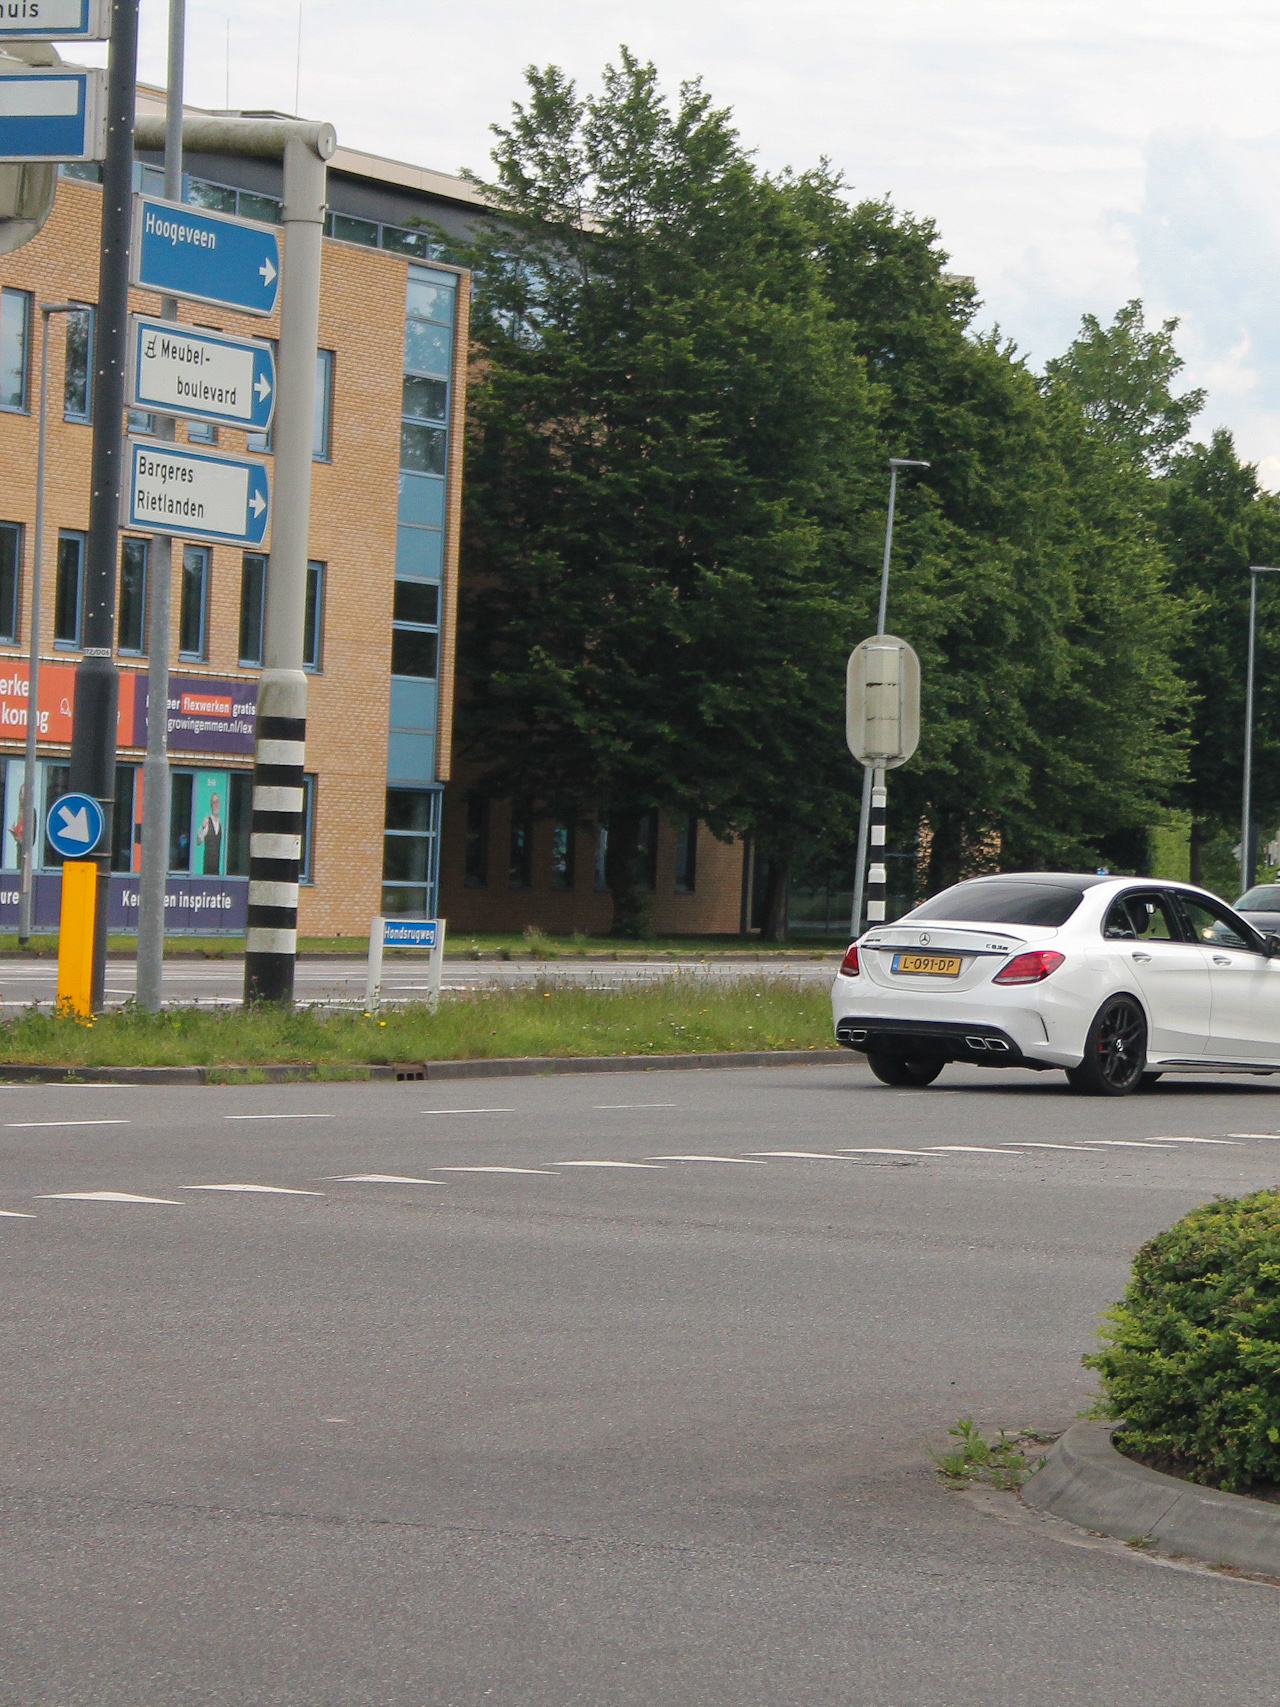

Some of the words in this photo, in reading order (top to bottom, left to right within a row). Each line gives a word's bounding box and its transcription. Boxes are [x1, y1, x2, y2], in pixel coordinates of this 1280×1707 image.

[145, 212, 217, 250] Hoogeveen
[161, 338, 211, 366] Meubel-
[176, 376, 238, 406] boulevard
[139, 456, 194, 484] Bargeres
[137, 490, 204, 518] Rietlanden
[0, 673, 30, 697] erke
[183, 696, 230, 714] flexwerken
[232, 701, 256, 718] gratis
[178, 891, 232, 913] inspiratie
[384, 925, 435, 944] Hondsrugweg
[902, 957, 955, 972] L-091-DP
